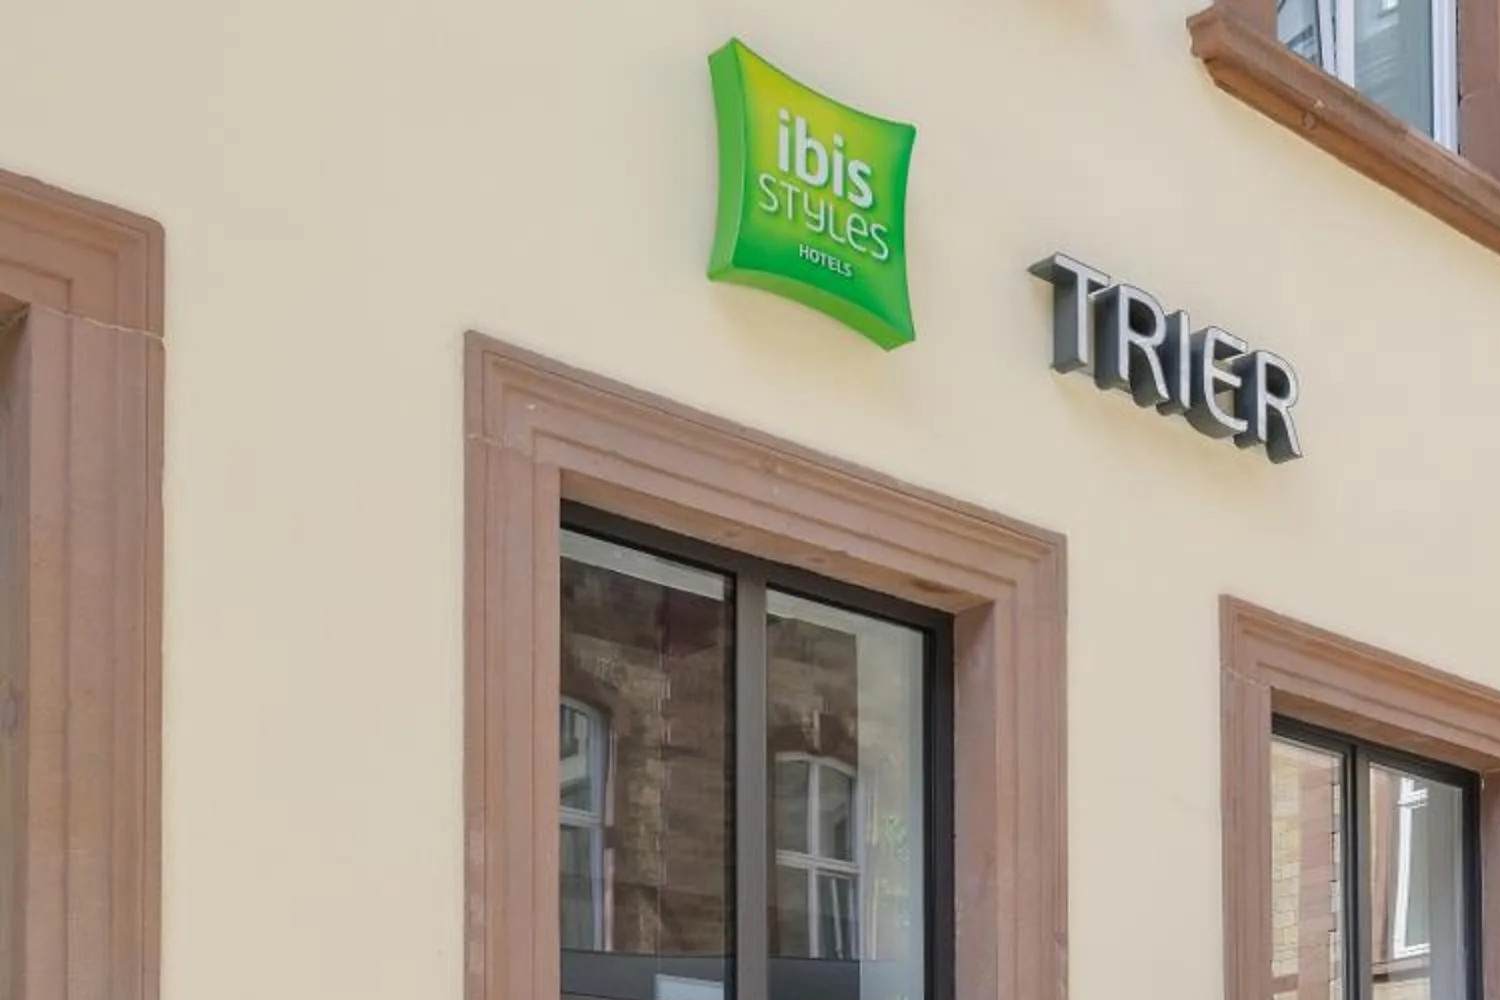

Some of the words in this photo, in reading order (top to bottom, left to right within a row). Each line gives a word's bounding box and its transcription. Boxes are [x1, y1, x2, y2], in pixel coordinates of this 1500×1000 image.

[777, 108, 873, 209] ibis
[799, 243, 853, 278] HOTELS
[1042, 252, 1303, 460] TRIER
